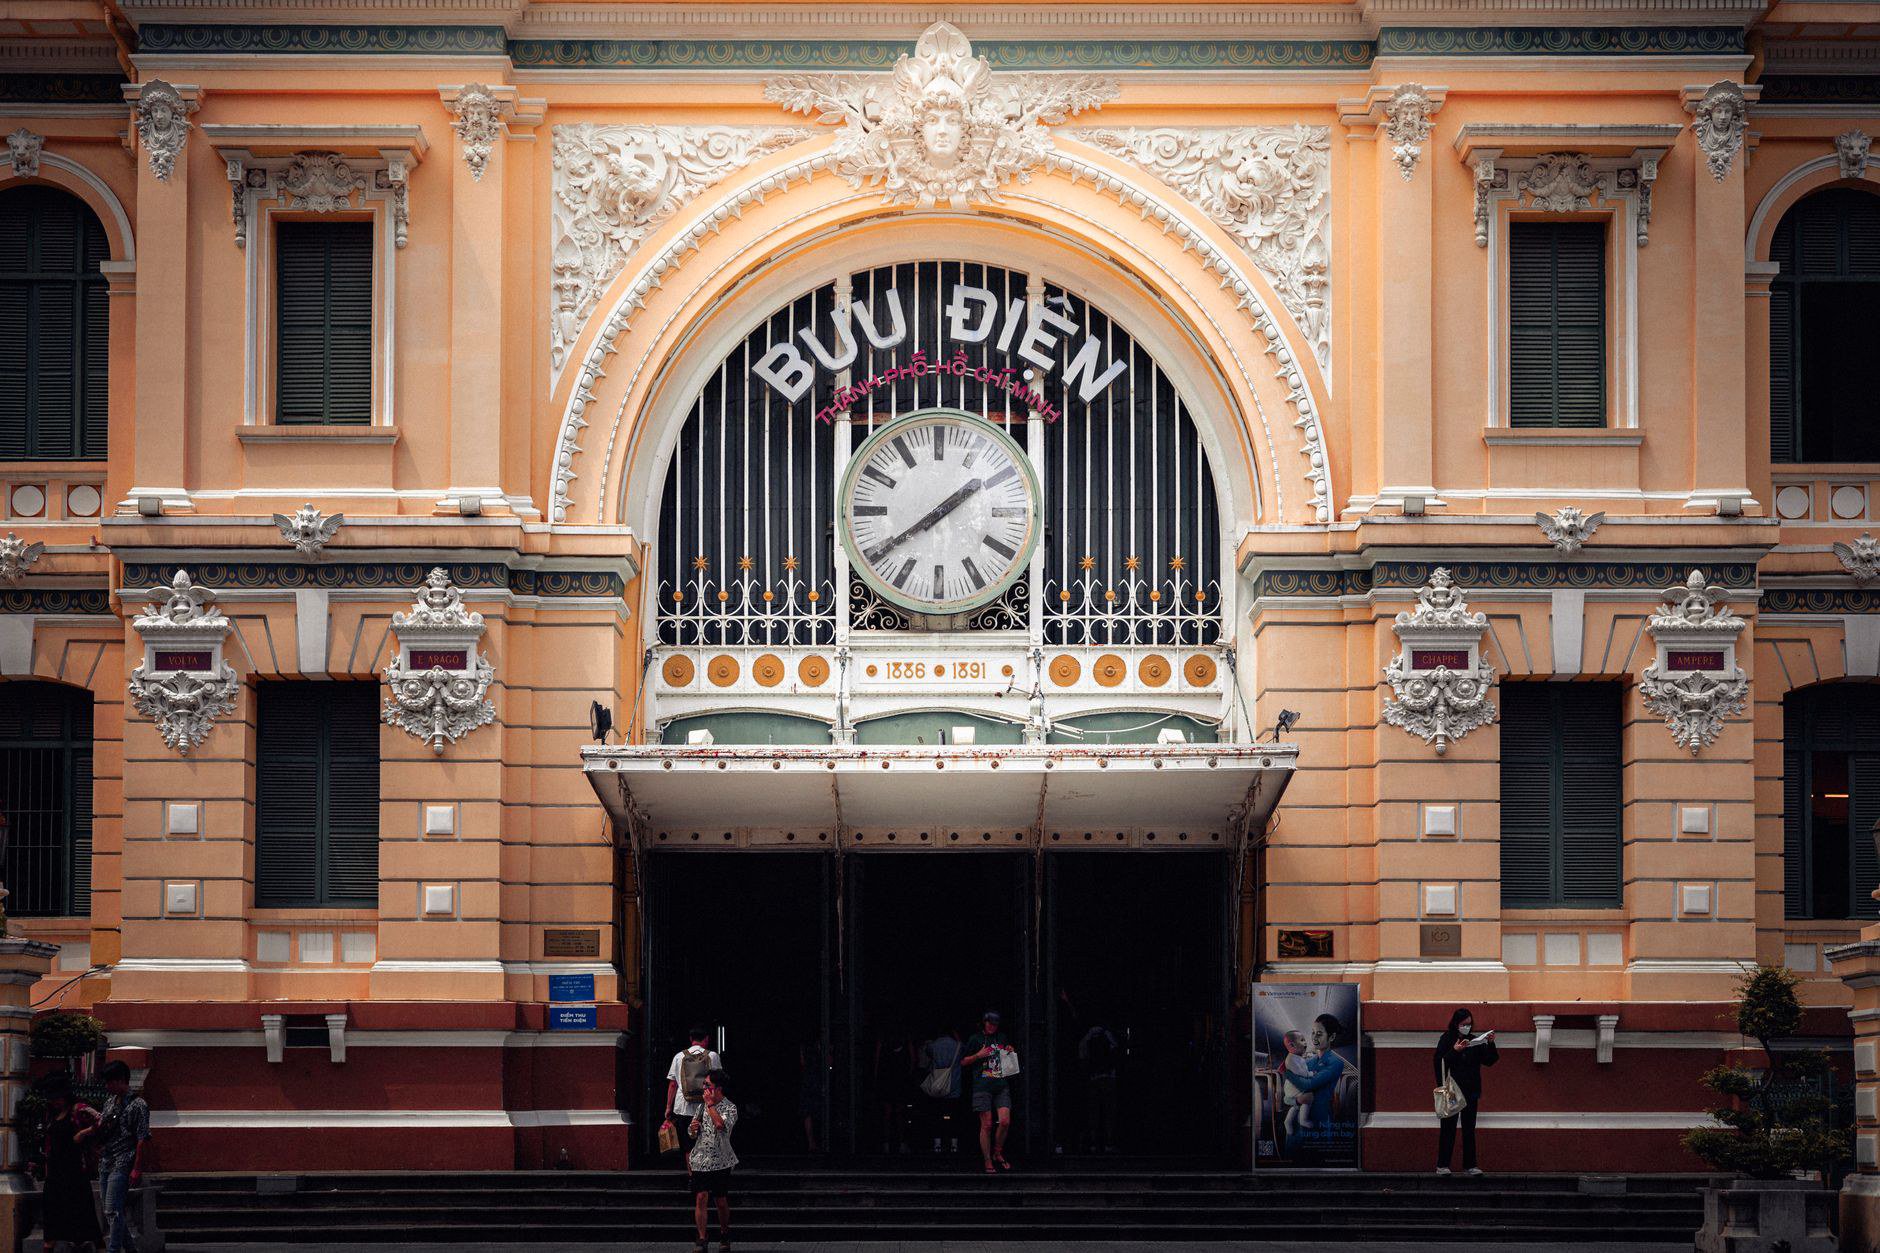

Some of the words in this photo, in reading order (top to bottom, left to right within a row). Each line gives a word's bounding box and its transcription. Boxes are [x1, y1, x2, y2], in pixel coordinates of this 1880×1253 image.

[751, 288, 907, 406] BƯU
[945, 284, 1128, 406] ĐIỆN
[816, 374, 882, 426] THÀNH
[884, 349, 928, 385] PHỐ
[935, 350, 969, 377] HỒ
[1009, 379, 1062, 425] MINH
[168, 656, 198, 665] VOLTA
[428, 655, 459, 664] ARAGO
[1422, 655, 1459, 664] CHAPPE
[886, 662, 926, 679] 1886
[953, 662, 986, 679] 1891
